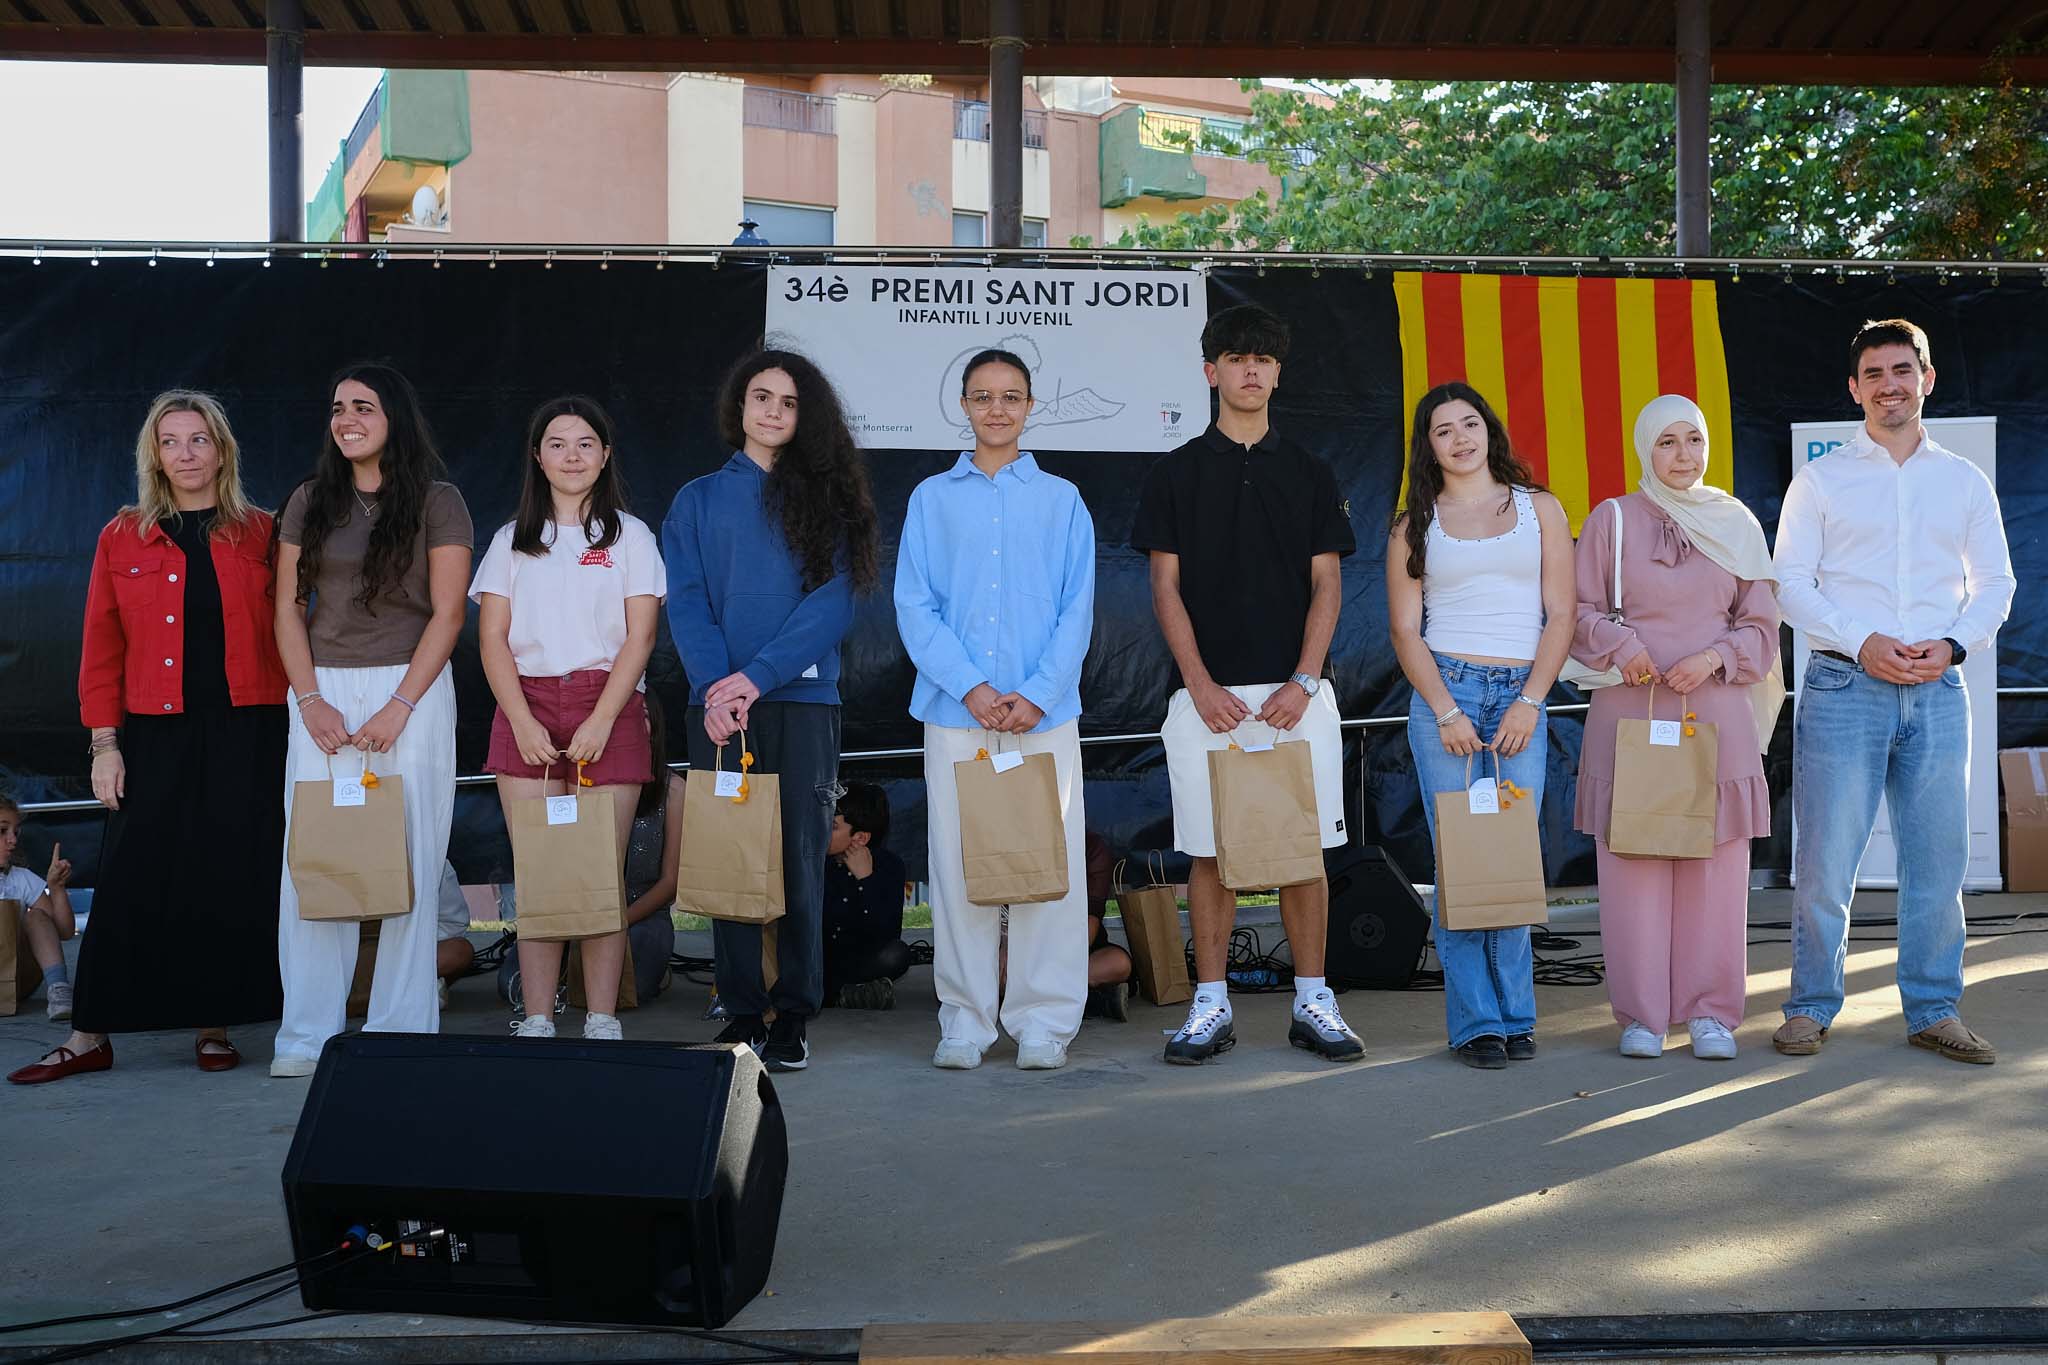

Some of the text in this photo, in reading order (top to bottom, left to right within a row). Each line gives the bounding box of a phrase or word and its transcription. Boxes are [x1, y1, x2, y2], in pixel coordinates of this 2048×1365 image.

[784, 274, 1189, 308] 34è PREMI SANT JORDI
[899, 308, 1073, 326] INFANTIL I JUVENIL
[863, 423, 913, 432] Montserrat
